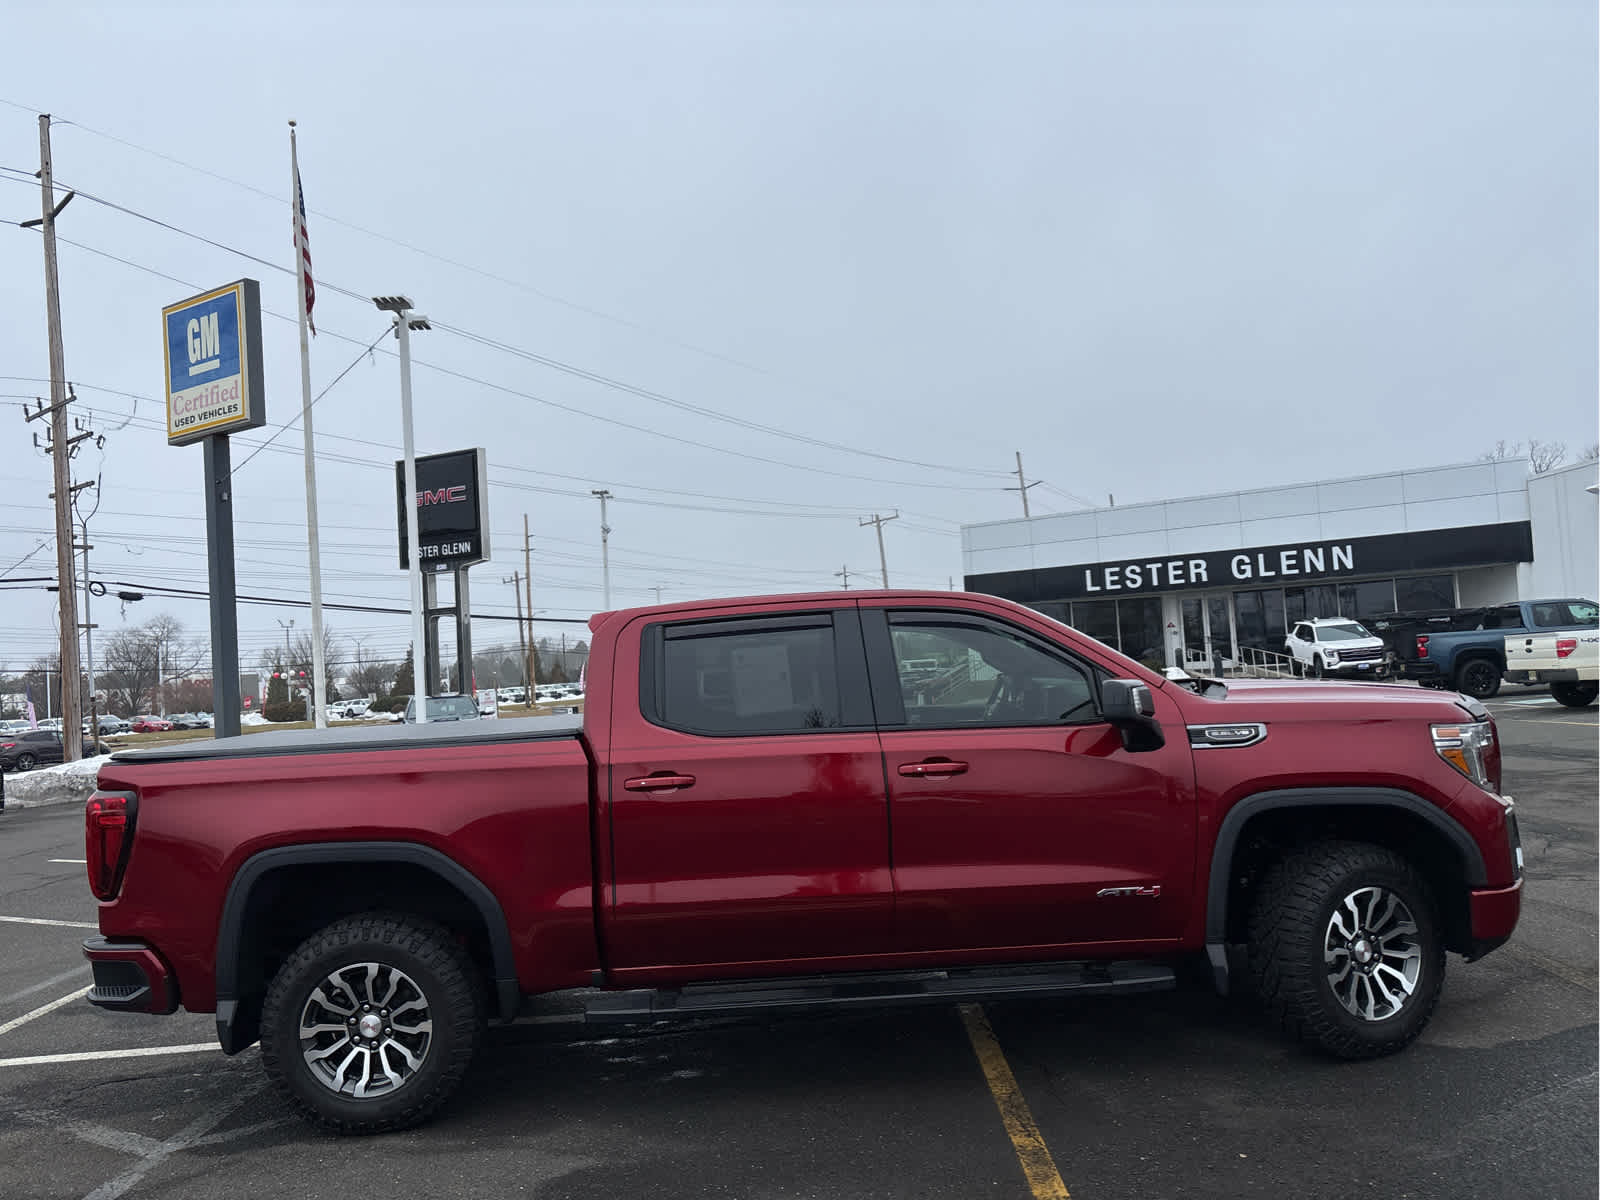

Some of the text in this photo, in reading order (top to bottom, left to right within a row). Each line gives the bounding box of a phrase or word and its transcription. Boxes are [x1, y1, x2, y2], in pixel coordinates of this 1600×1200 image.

[187, 312, 220, 364] GM
[173, 379, 240, 416] Certified
[175, 403, 239, 428] USED VEHICLES
[418, 542, 471, 558] STER GLENN
[1085, 545, 1354, 592] LESTER GLENN
